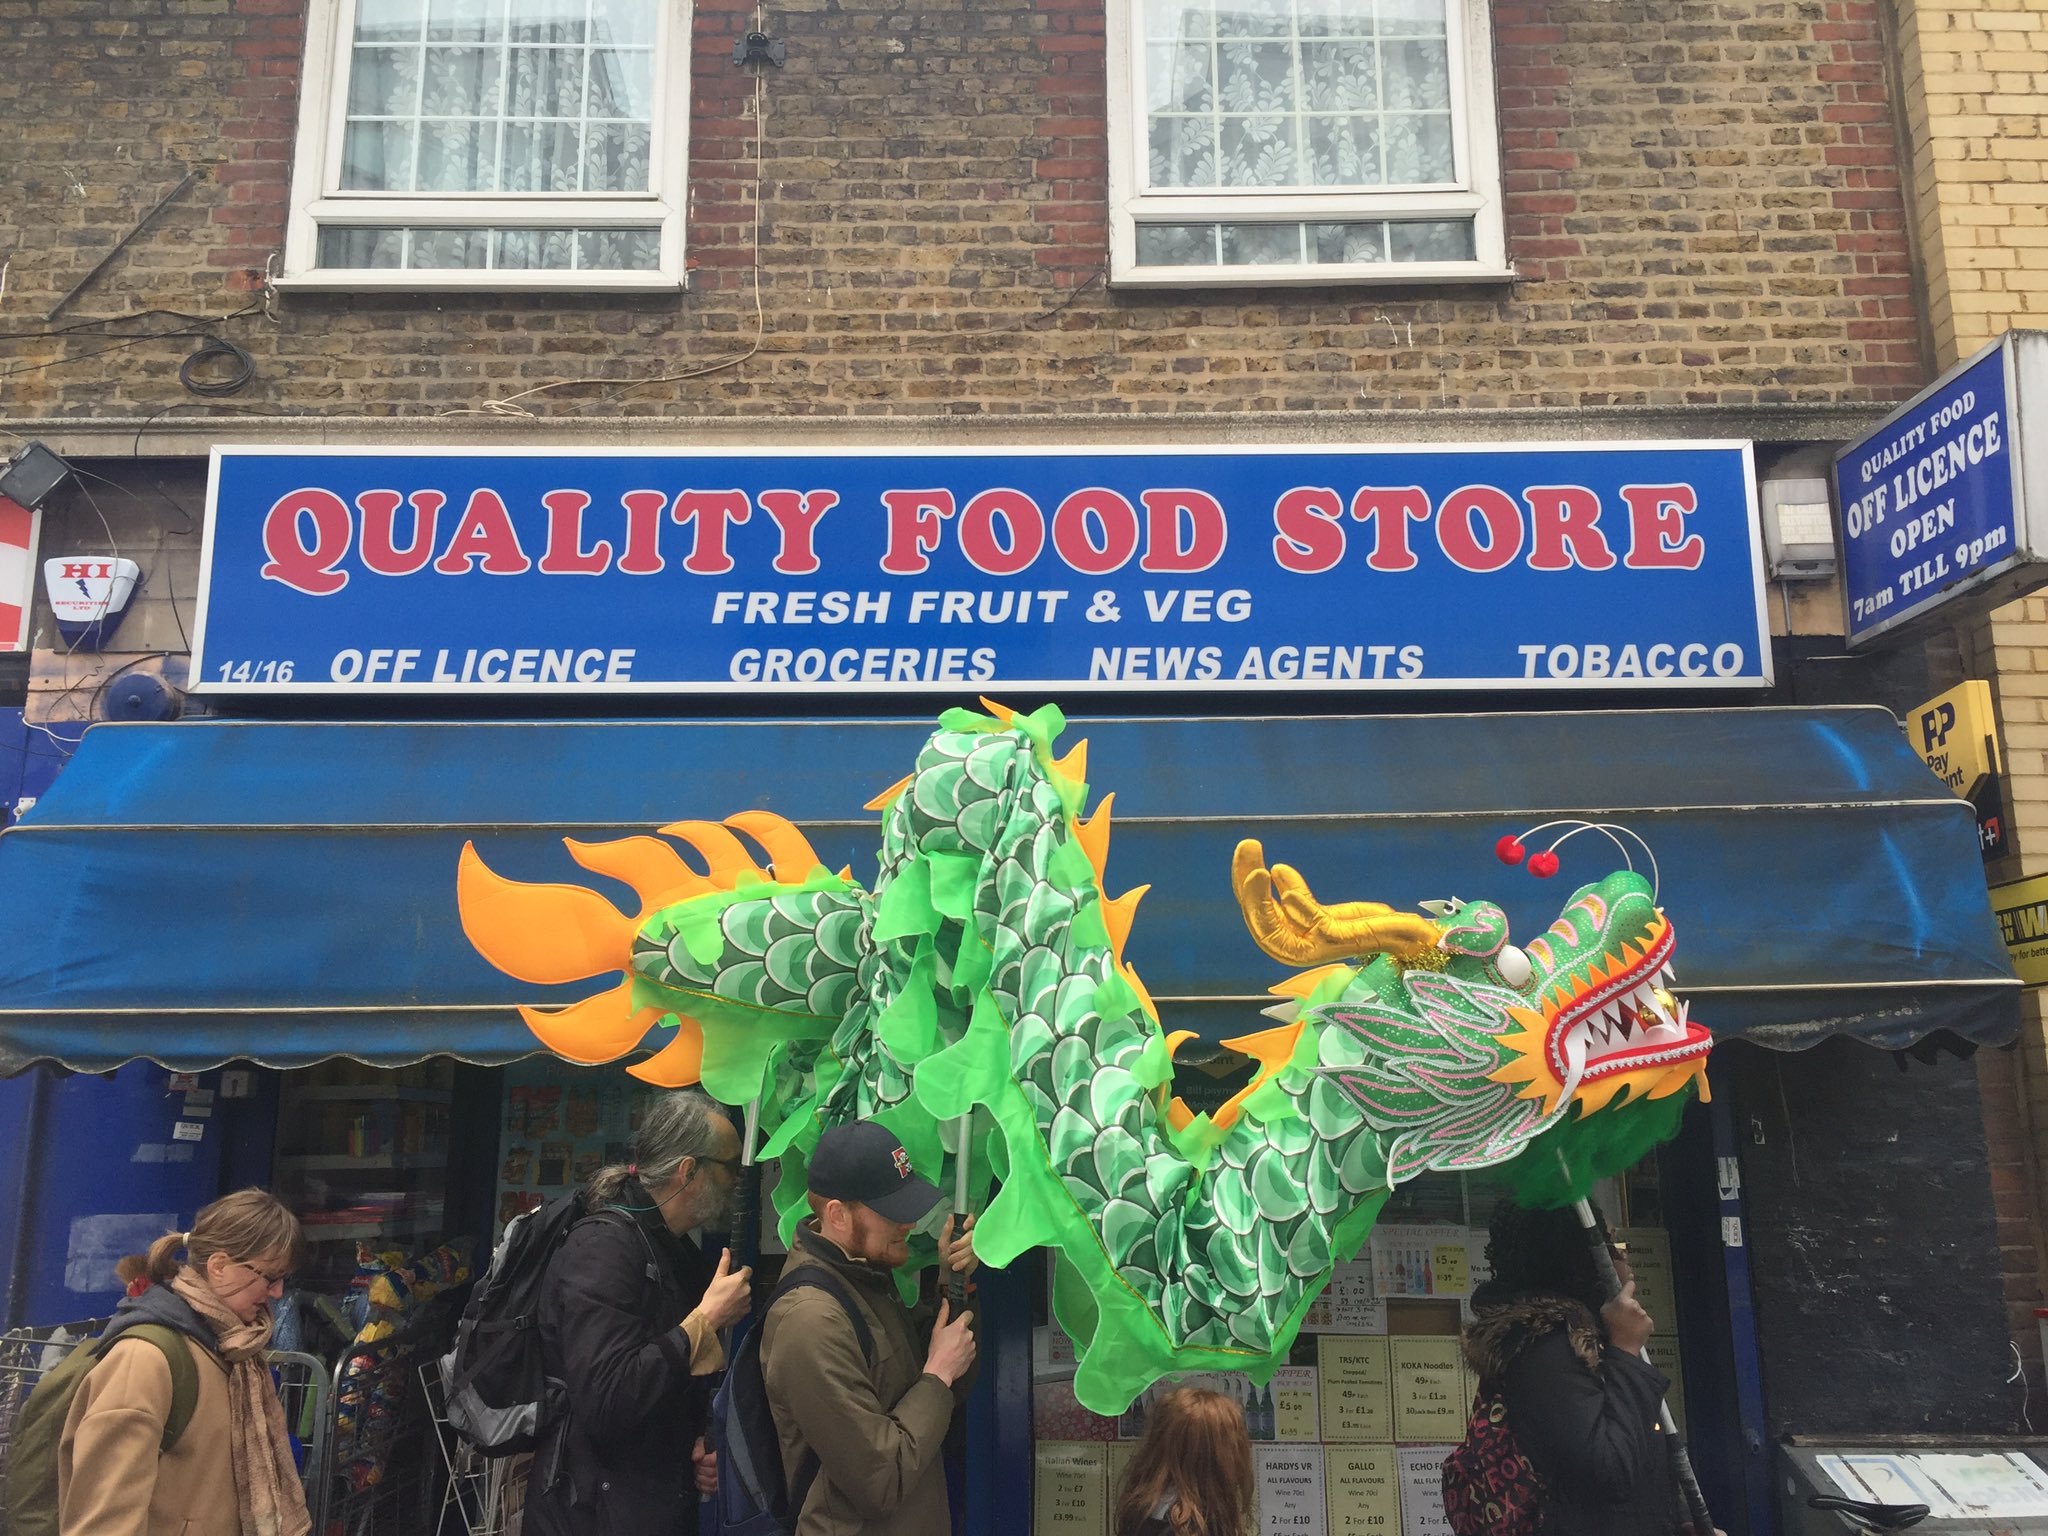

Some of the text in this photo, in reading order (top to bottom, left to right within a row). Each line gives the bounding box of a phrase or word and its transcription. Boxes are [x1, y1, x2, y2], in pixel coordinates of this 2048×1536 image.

[1861, 390, 1976, 483] QUALITY FOOD
[1847, 411, 2001, 539] OFF LICENCE
[1890, 498, 1955, 558] OPEN
[260, 482, 1706, 596] QUALITY FOOD STORE
[1853, 524, 2006, 622] 7am TILL 9pm
[711, 589, 1252, 624] FRESH FRUIT & VEG
[729, 647, 997, 682] GROCERIES
[1088, 645, 1424, 680] NEWS AGENTS
[1517, 642, 1744, 678] TOBACCO
[330, 648, 636, 683] OFF LICENCE
[218, 660, 295, 683] 14/16
[1926, 751, 1949, 775] Pay
[1657, 1348, 1674, 1356] HILL
[1338, 1356, 1370, 1365] TRS/KTC
[1412, 1392, 1417, 1400] 3
[1338, 1405, 1344, 1413] 3
[1072, 1457, 1098, 1466] Wines
[1266, 1462, 1313, 1471] HARDYS VR
[1348, 1462, 1375, 1471] GALLO
[1410, 1462, 1433, 1471] ECHO
[1074, 1485, 1084, 1493] £7
[1071, 1499, 1086, 1507] £10
[1357, 1502, 1370, 1510] Any
[1053, 1513, 1074, 1521] £3.99
[1271, 1515, 1277, 1524] 2
[1293, 1515, 1311, 1525] £10
[1345, 1516, 1384, 1525] 2 For £10
[1419, 1516, 1426, 1525] 2
[1428, 1517, 1440, 1525] For
